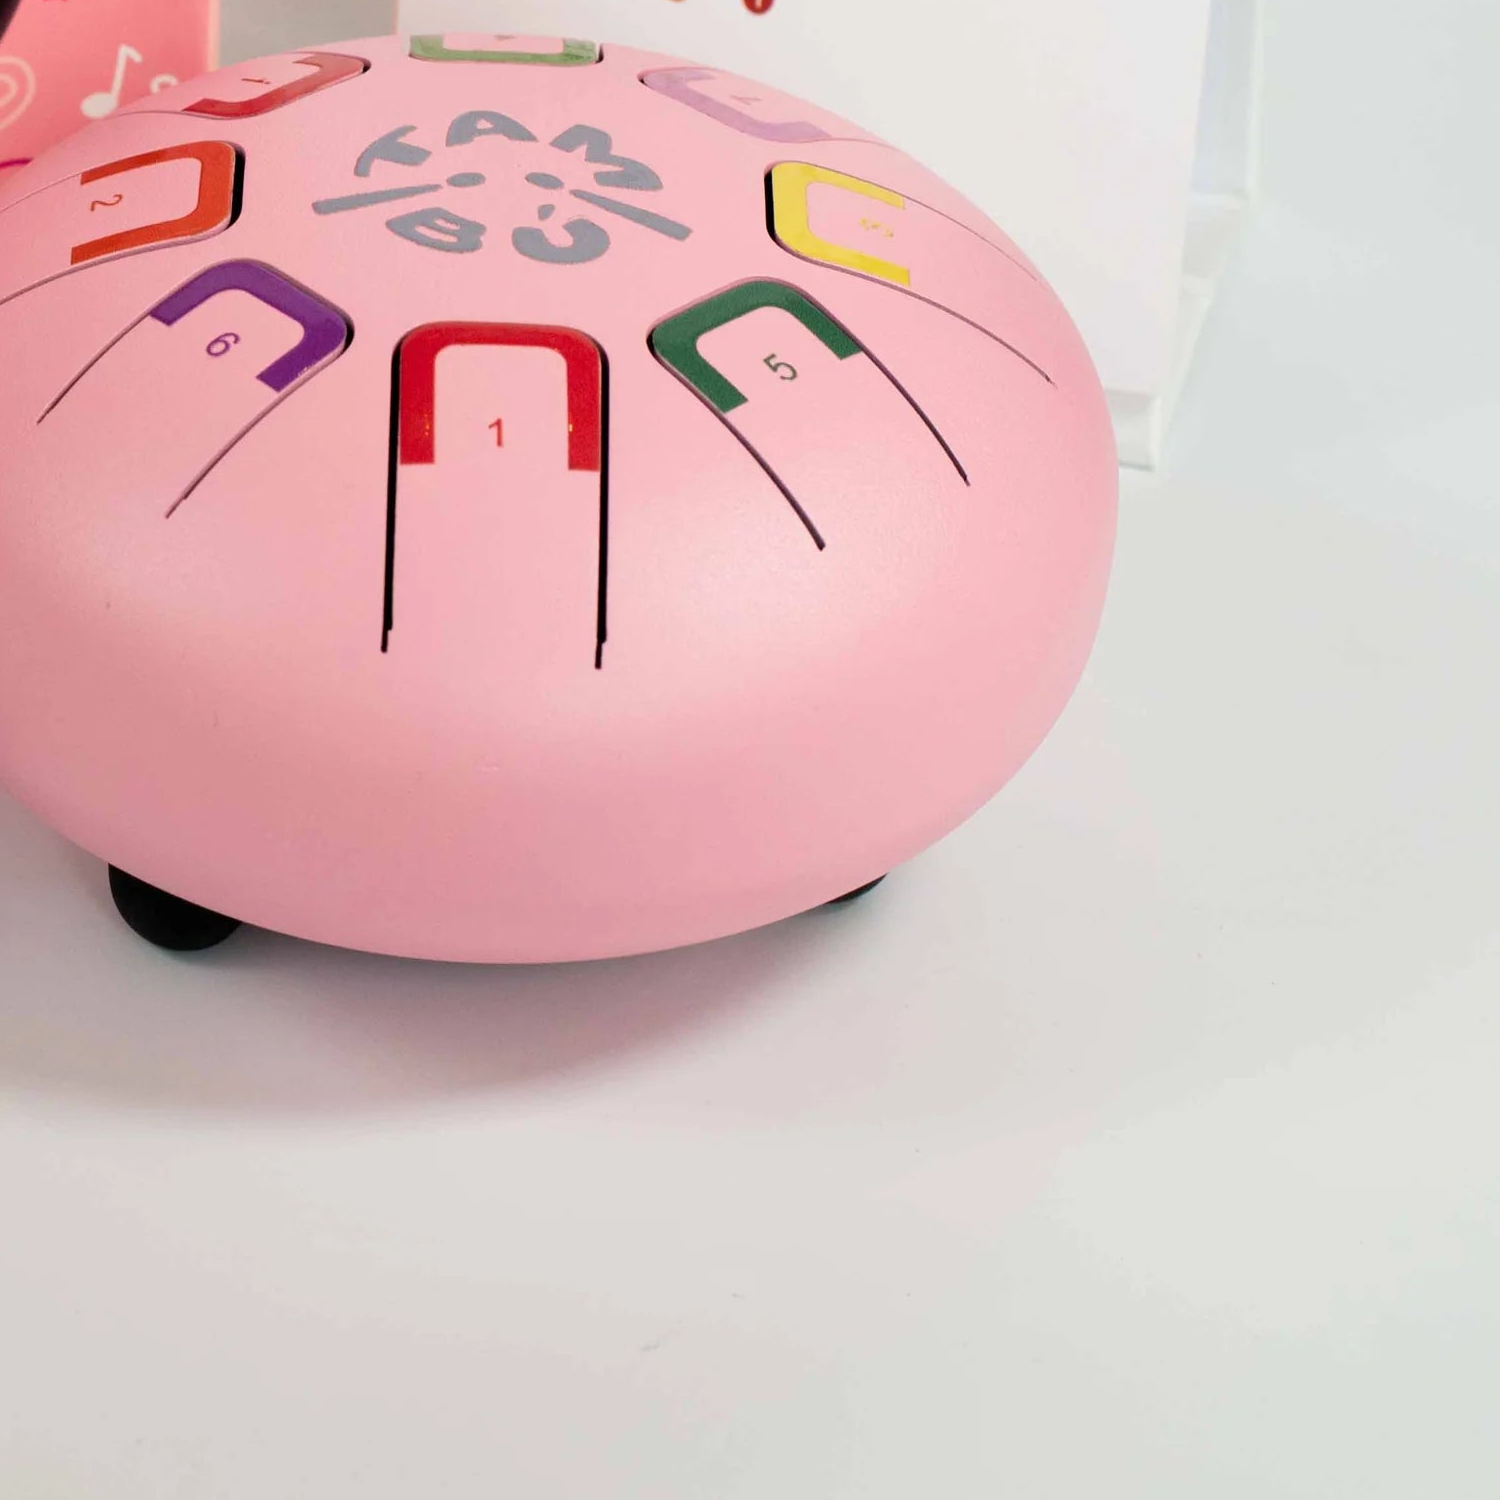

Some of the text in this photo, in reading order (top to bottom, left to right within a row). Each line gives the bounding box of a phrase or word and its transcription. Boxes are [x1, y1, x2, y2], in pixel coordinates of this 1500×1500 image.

[89, 192, 124, 213] 2
[204, 332, 241, 358] 6
[762, 351, 799, 382] 5
[487, 417, 504, 449] 1
